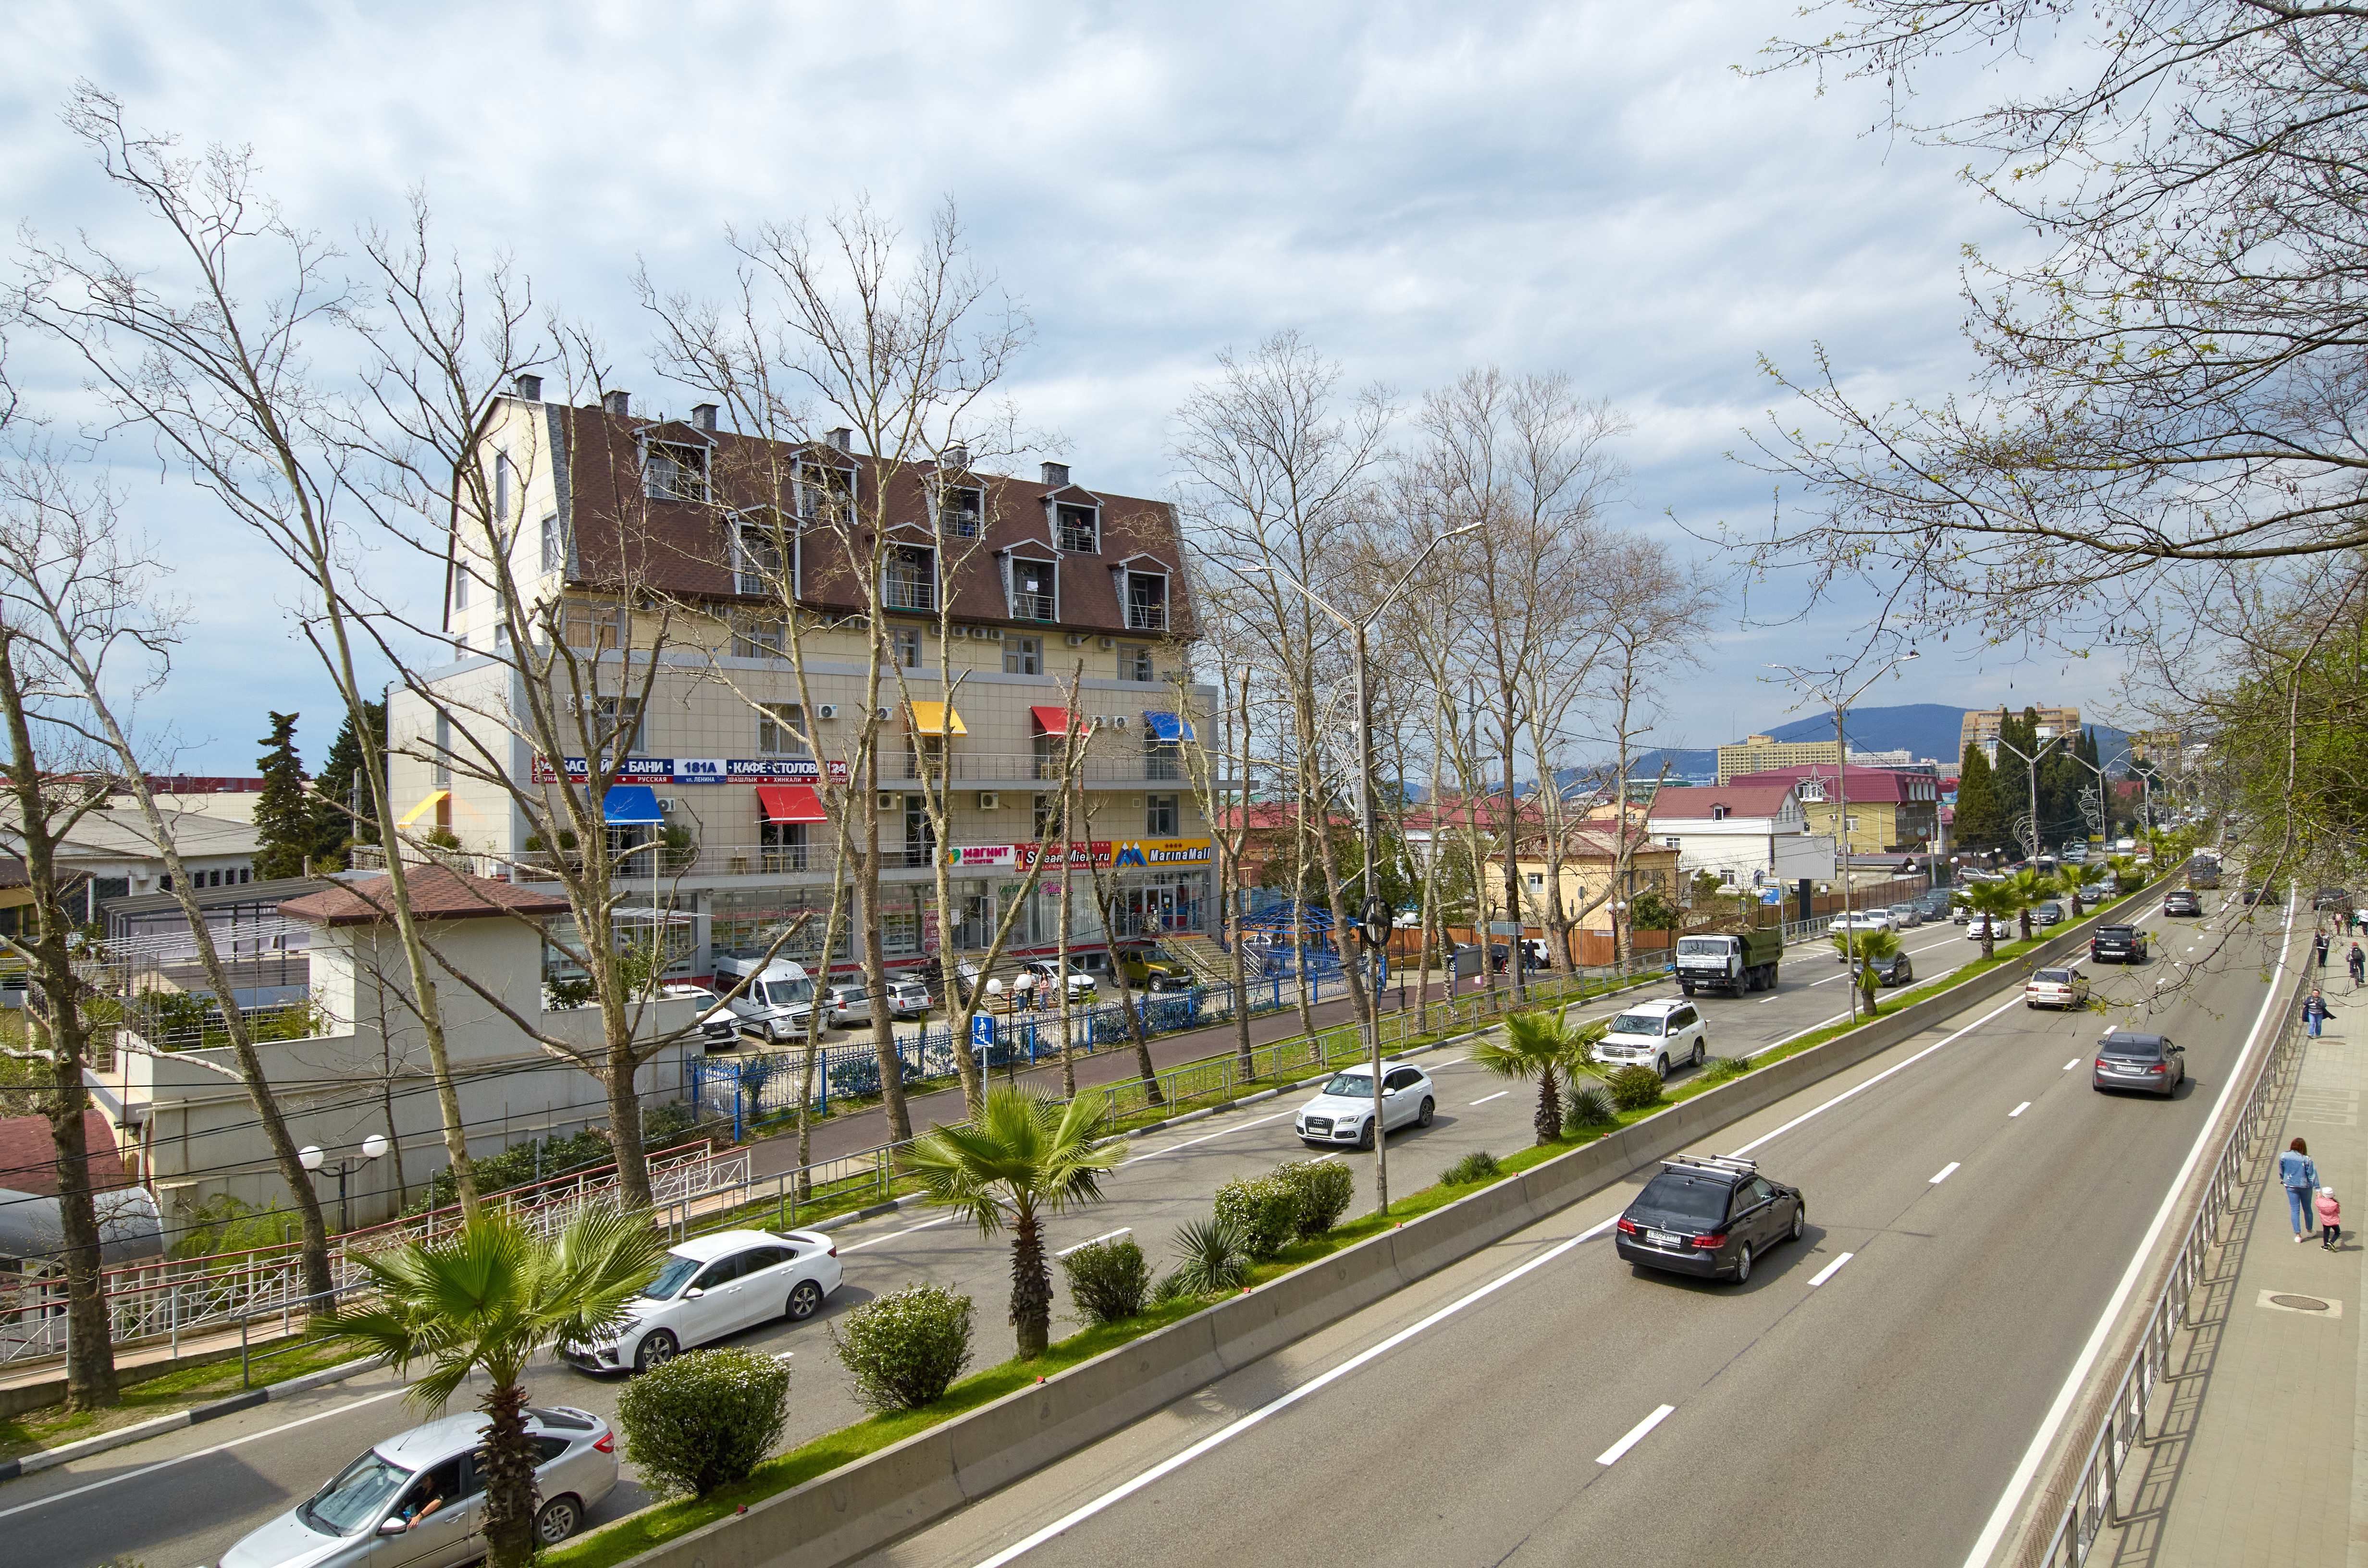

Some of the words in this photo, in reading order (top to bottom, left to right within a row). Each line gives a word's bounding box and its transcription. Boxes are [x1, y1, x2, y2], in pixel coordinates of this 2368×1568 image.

[629, 761, 663, 772] БАНИ
[733, 762, 766, 773] КАФЕ
[773, 763, 830, 774] СТОЛОВ
[831, 763, 846, 774] 24
[1150, 847, 1210, 861] MarinaMall
